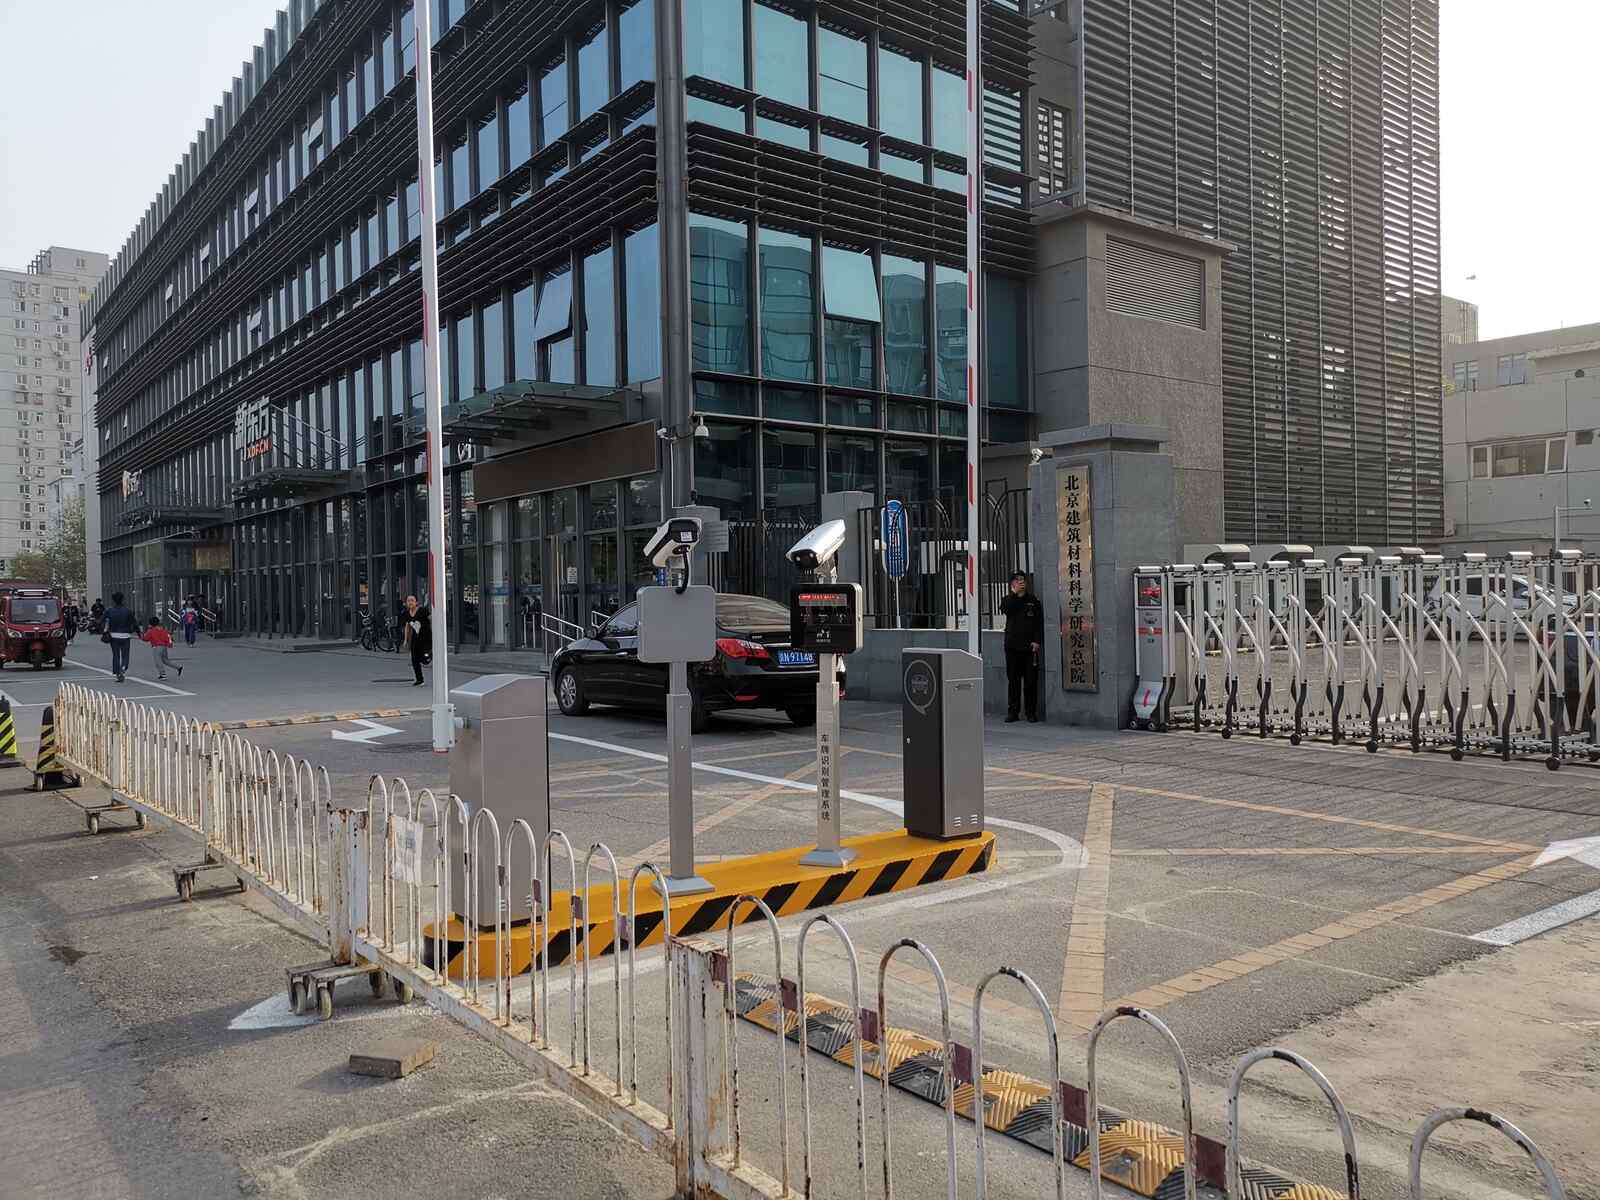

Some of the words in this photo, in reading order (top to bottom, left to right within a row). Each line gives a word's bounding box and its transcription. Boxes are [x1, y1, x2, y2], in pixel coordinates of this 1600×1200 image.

[235, 395, 270, 456] 新东方
[1065, 475, 1086, 684] 北京建筑材料科学研究总院
[821, 734, 830, 821] 车牌识别管理系统
